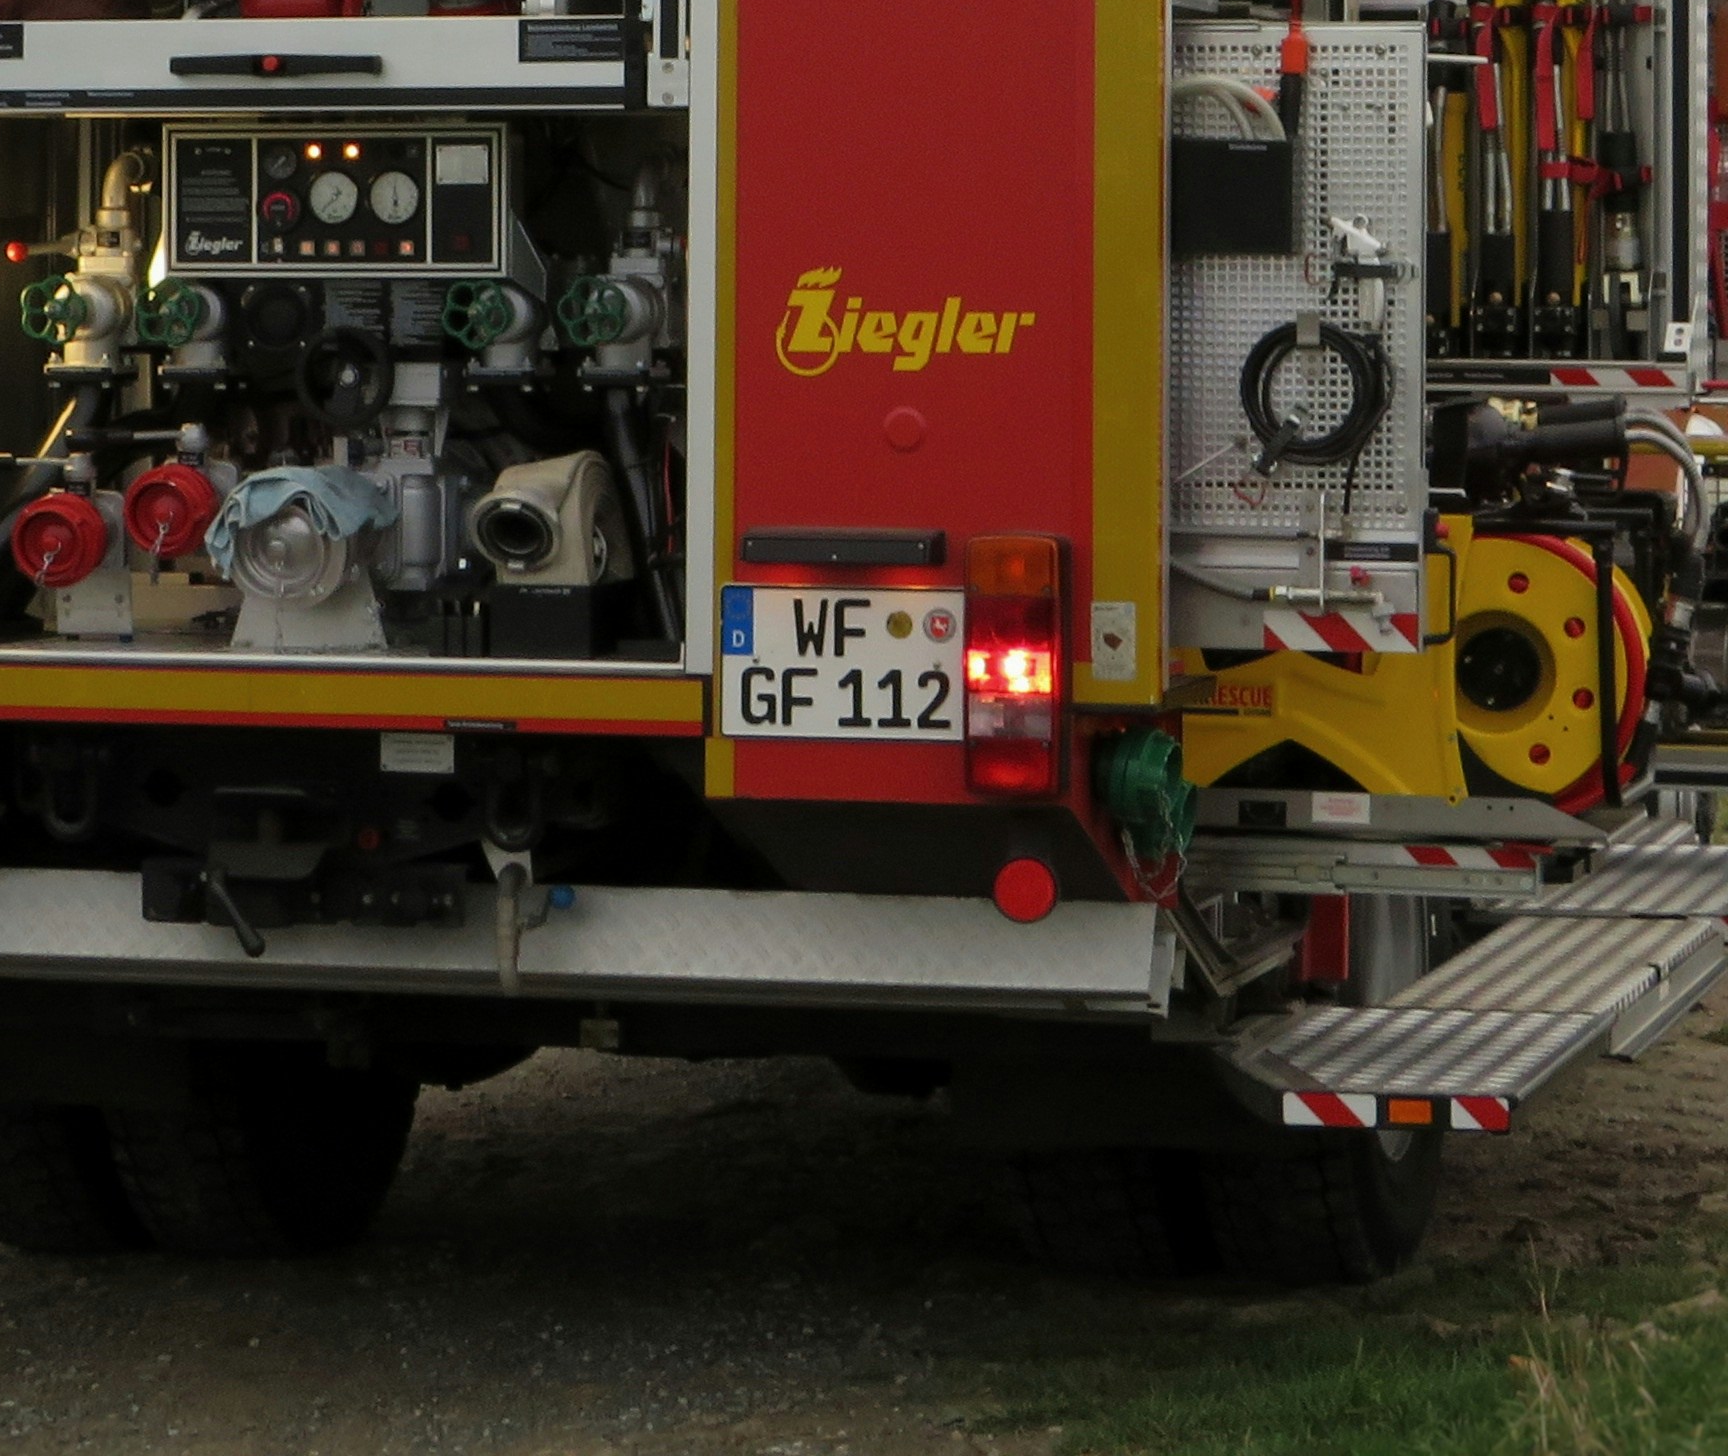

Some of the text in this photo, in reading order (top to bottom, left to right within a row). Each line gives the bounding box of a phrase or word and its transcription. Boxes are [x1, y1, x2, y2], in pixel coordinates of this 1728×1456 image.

[184, 232, 244, 256] Ziegler
[775, 284, 1036, 377] Ziegler
[732, 630, 745, 648] D
[792, 598, 871, 657] WF
[741, 666, 951, 729] GF 112
